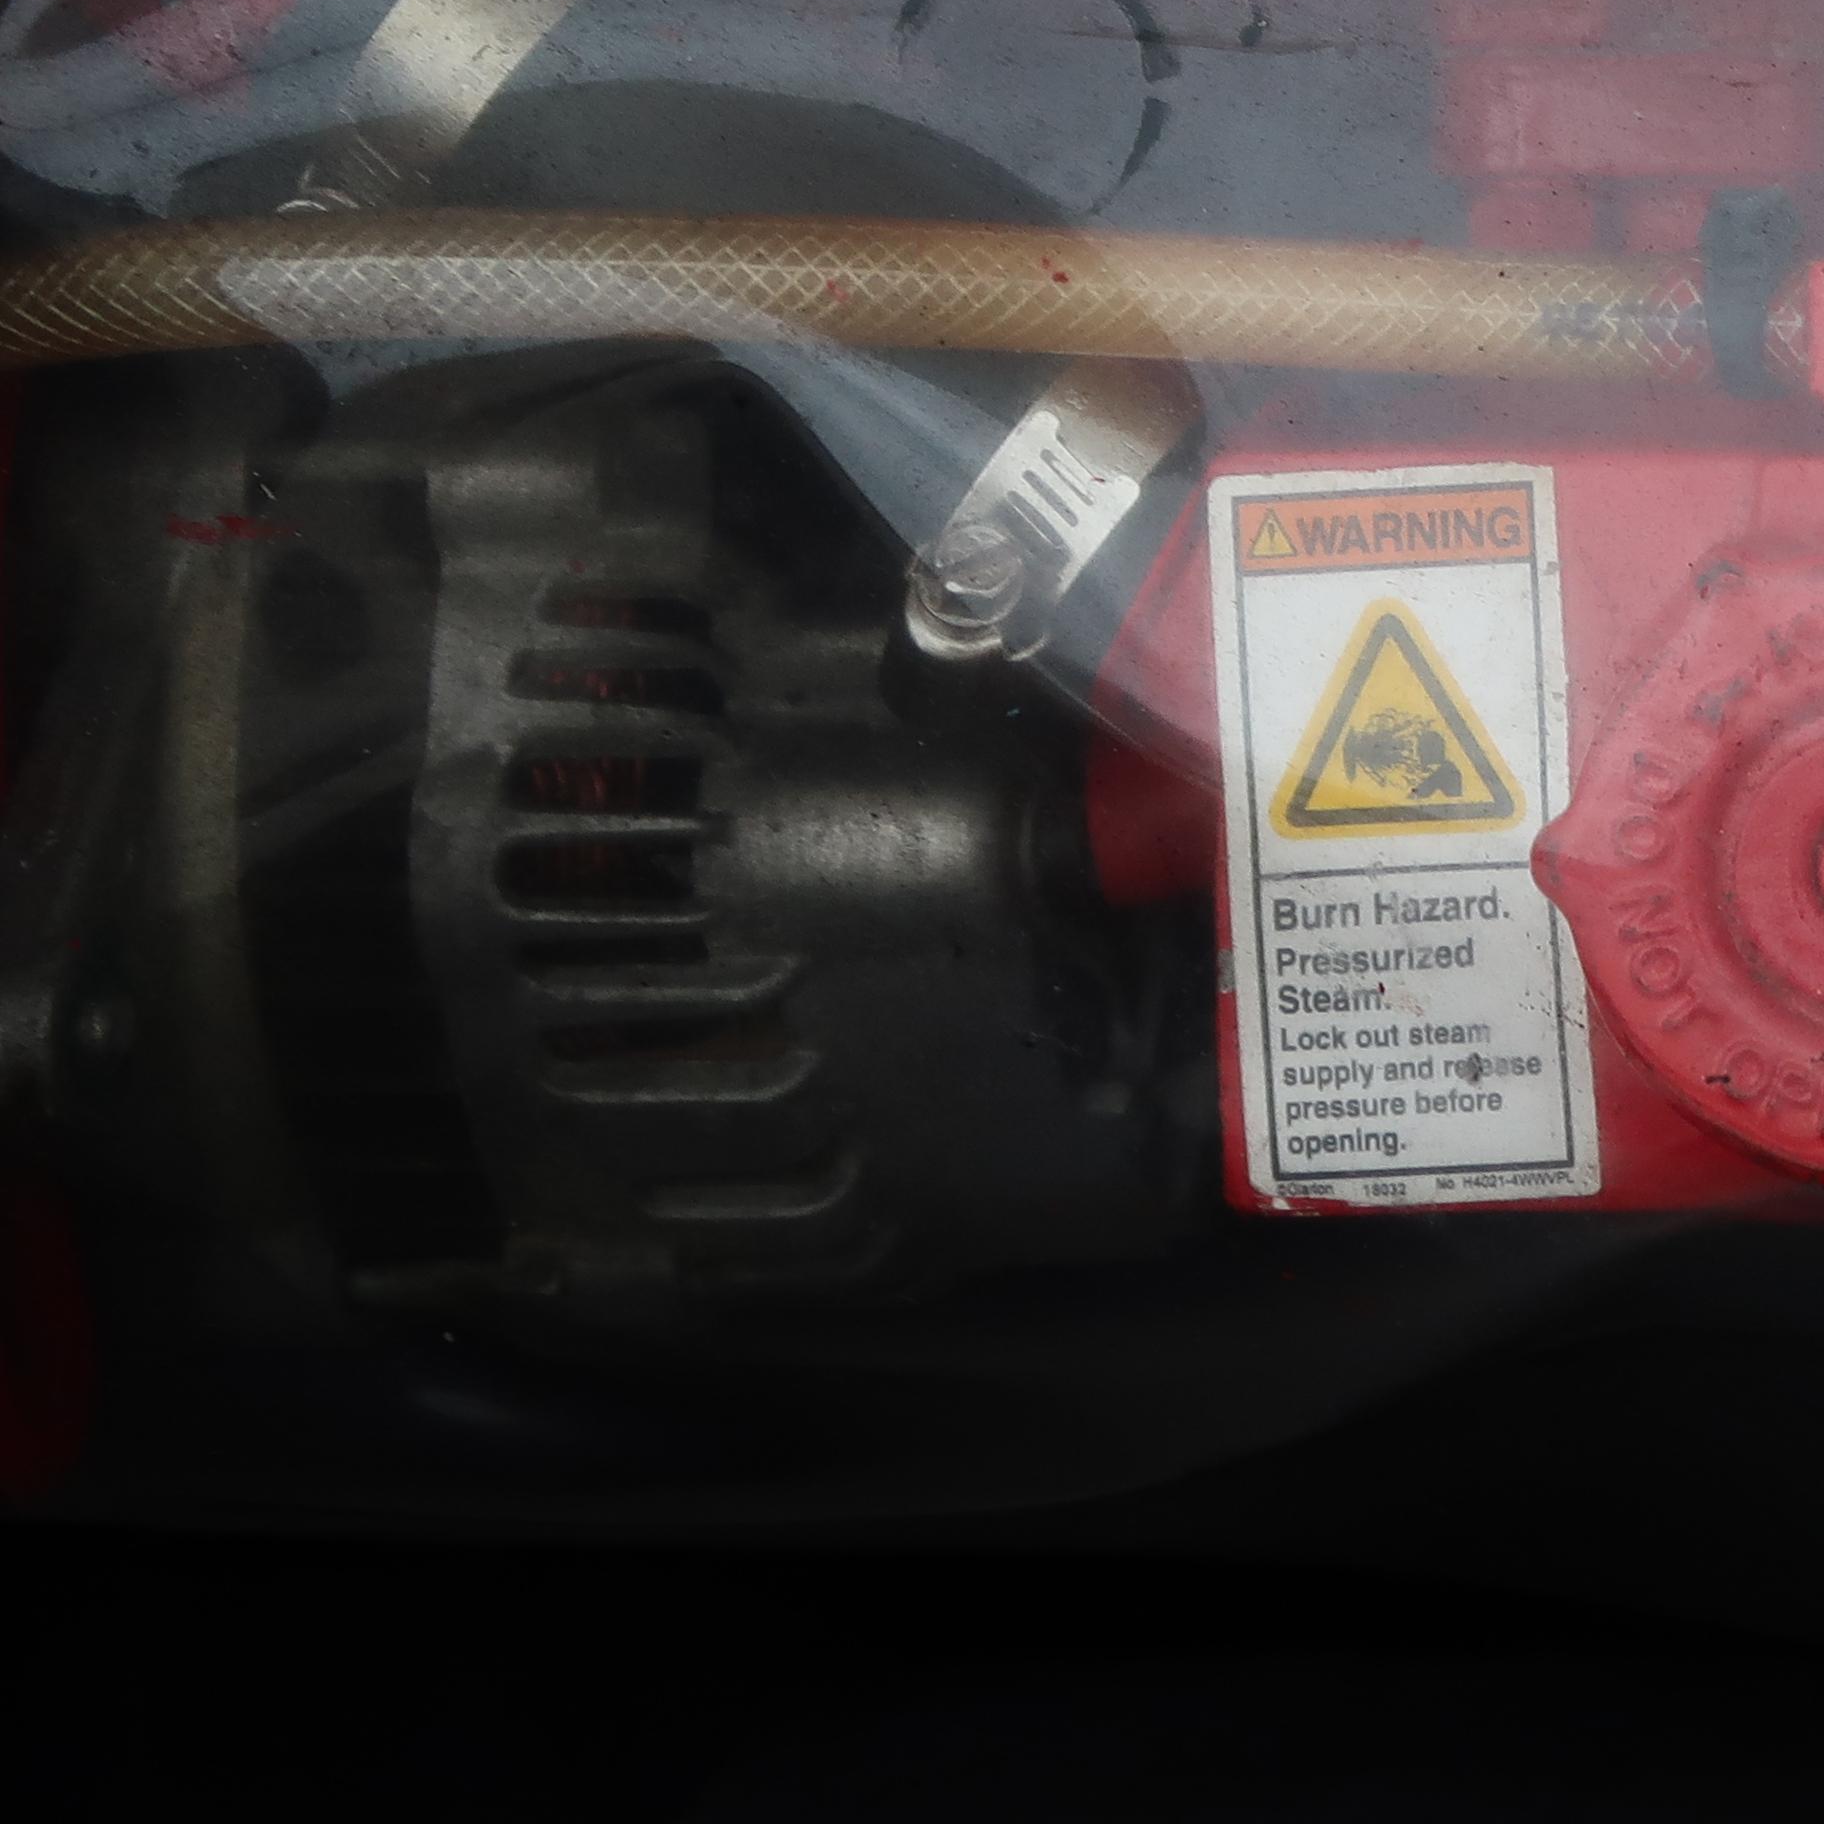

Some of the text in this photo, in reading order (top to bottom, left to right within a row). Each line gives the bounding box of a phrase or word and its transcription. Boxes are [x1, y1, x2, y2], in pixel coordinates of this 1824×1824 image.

[1298, 507, 1522, 556] WARNING
[1611, 751, 1682, 865] DO
[1272, 888, 1510, 931] Burn Hazard.
[1276, 941, 1474, 979] Pressurized
[1614, 884, 1710, 1031] NOT
[1279, 982, 1390, 1014] Steam.
[1281, 1023, 1488, 1051] Lock out steam
[1283, 1060, 1373, 1091] supply
[1384, 1056, 1433, 1081] and
[1286, 1088, 1502, 1127] pressure before
[1288, 1128, 1406, 1159] opening.
